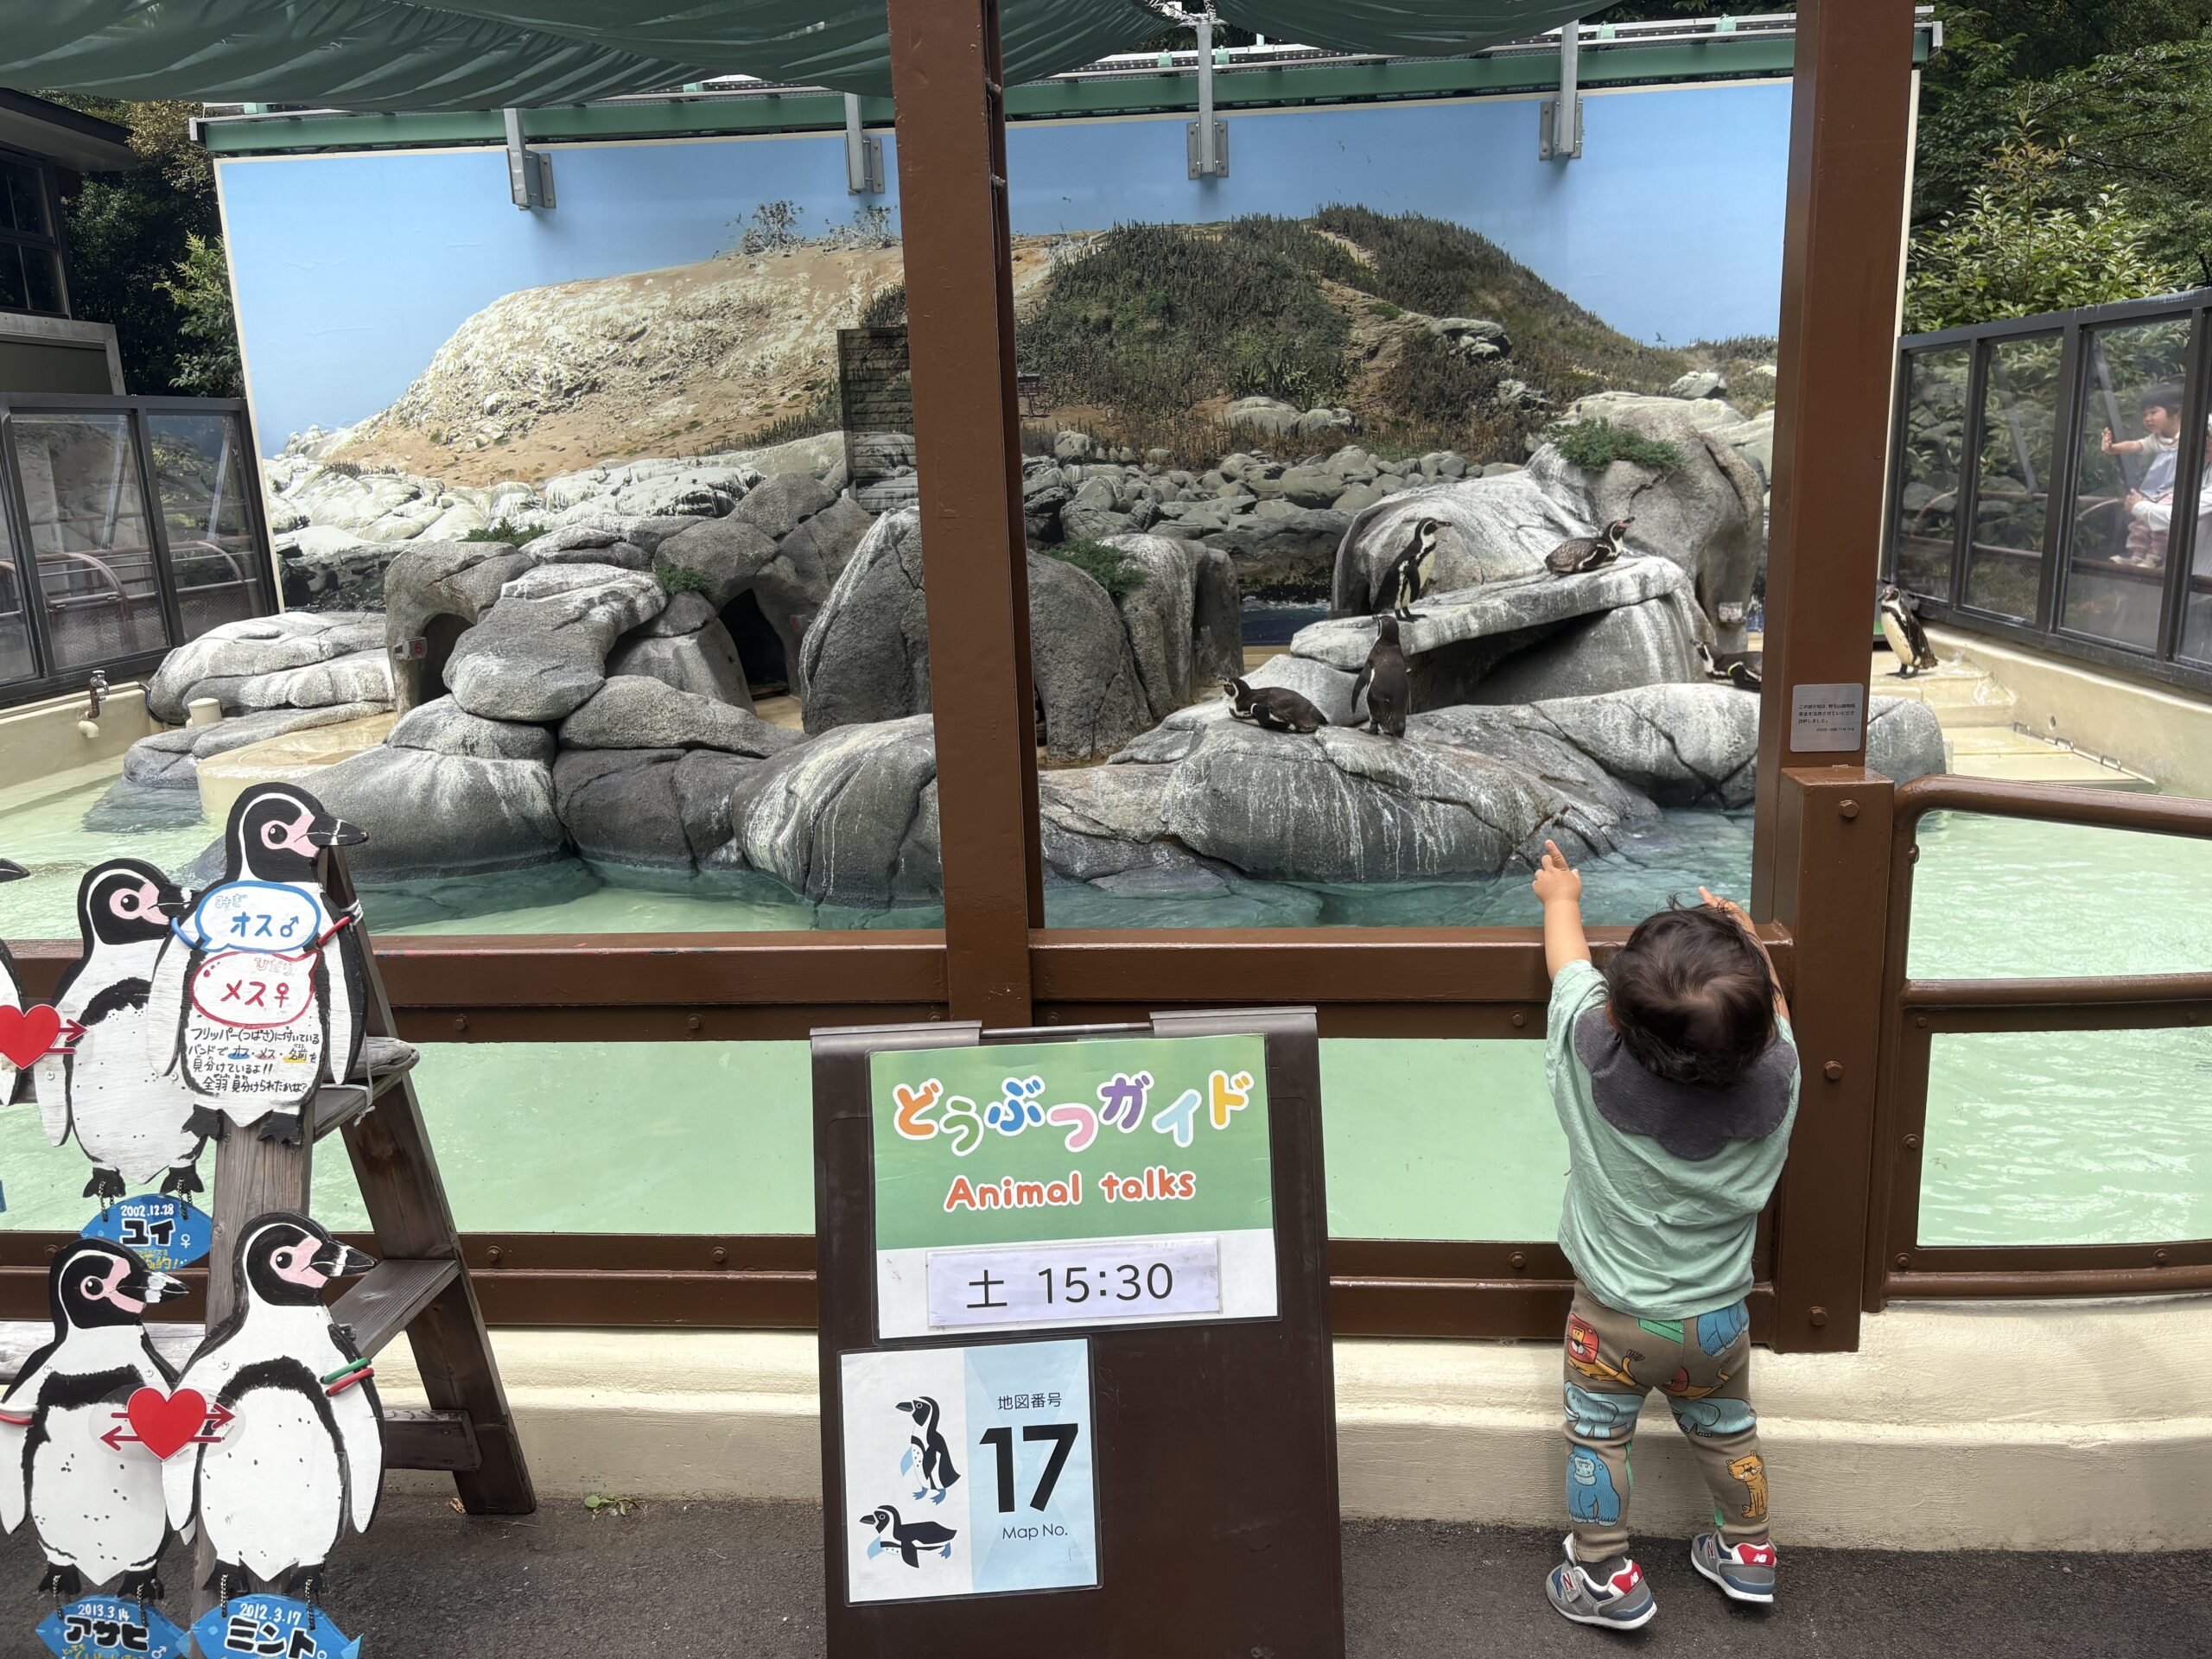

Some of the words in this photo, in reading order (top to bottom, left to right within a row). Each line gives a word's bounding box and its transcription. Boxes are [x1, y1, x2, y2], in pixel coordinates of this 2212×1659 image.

[215, 893, 248, 908] みぎ
[230, 912, 273, 938] オス
[220, 979, 264, 1007] メス
[894, 1071, 1253, 1155] どうぶつガイド
[944, 1170, 1082, 1211] Animal
[1099, 1166, 1196, 1201] talks
[121, 1203, 175, 1217] 2002.12.28
[119, 1218, 176, 1247] ユイ
[966, 1268, 1008, 1308] 土
[1038, 1262, 1173, 1304] 15:30
[998, 1392, 1063, 1410] 地図番号
[979, 1423, 1078, 1513] 17
[1002, 1526, 1039, 1541] Map
[1043, 1523, 1068, 1536] No.
[78, 1605, 130, 1621] 2013.3.14
[239, 1603, 302, 1625] 2012.3.17
[64, 1615, 149, 1652] アサヒ
[224, 1615, 317, 1659] ミント
